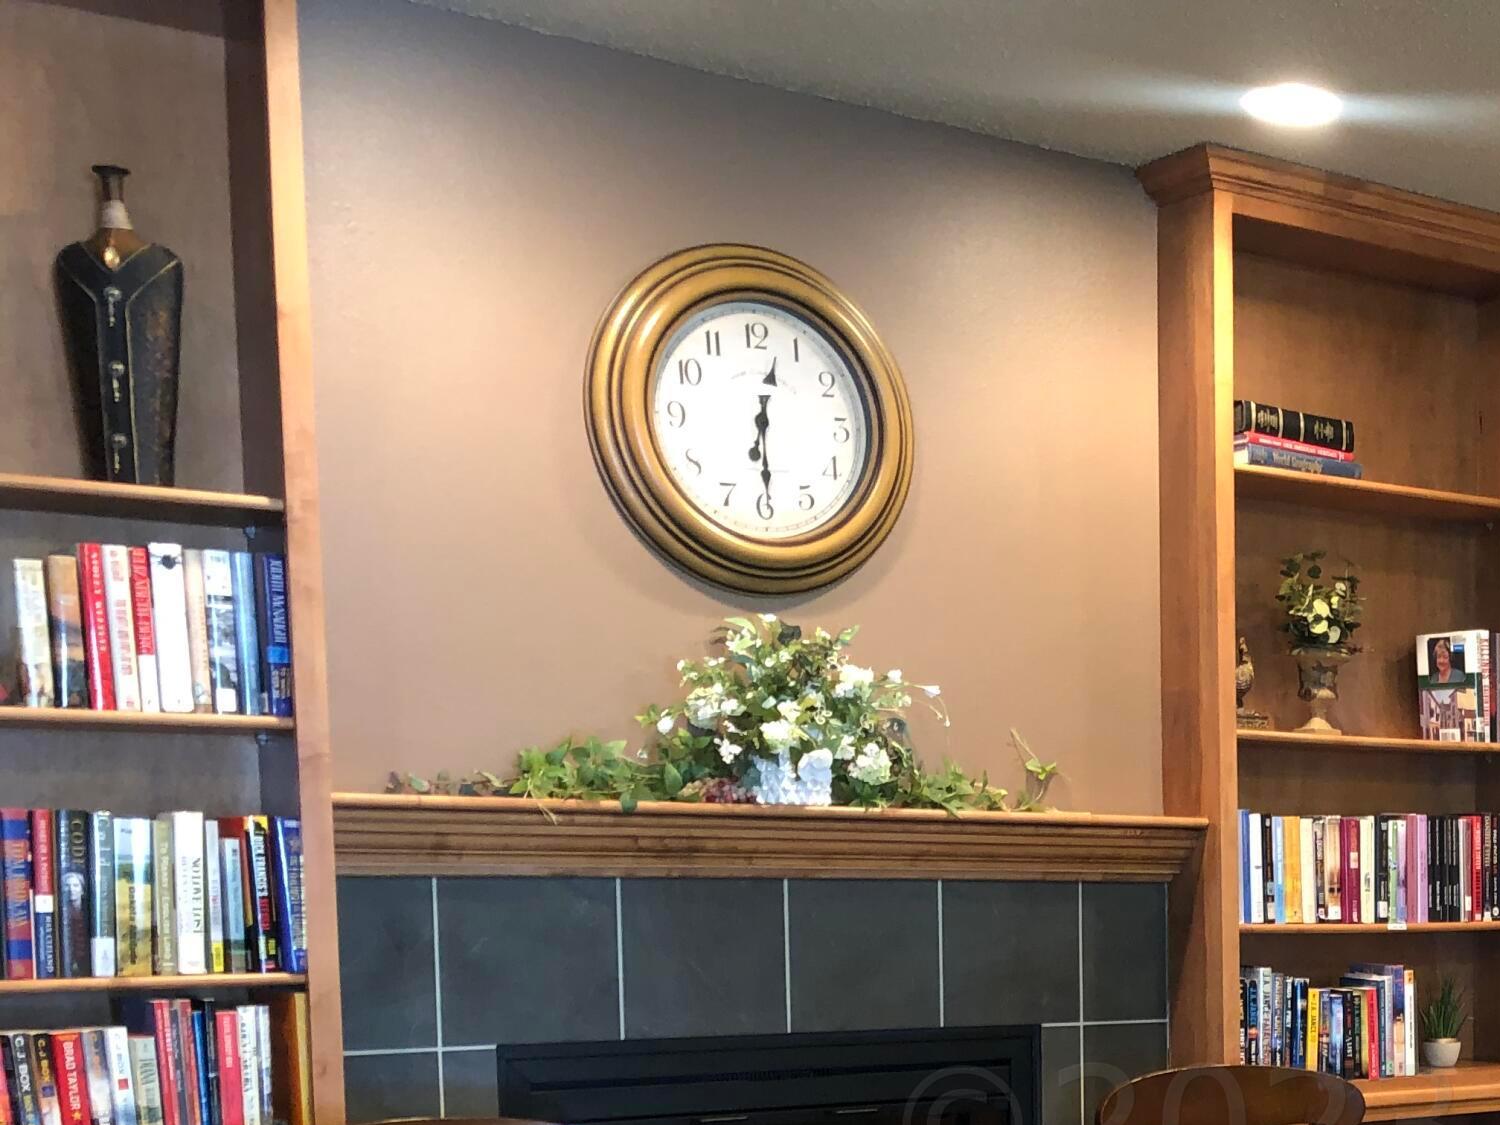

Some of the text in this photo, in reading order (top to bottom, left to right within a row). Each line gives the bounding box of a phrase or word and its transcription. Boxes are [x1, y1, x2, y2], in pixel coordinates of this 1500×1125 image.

[705, 330, 721, 356] 11
[744, 322, 769, 350] 12
[792, 337, 800, 363] 1
[678, 358, 702, 385] 10
[818, 371, 836, 398] 2
[666, 401, 686, 428] 9
[833, 417, 850, 443] 3
[685, 448, 702, 475] 8
[821, 456, 842, 481] 4
[719, 482, 737, 507] 7
[756, 492, 775, 520] 6
[798, 485, 815, 511] 5
[270, 559, 284, 592] JUDITH
[254, 836, 266, 855] DICK
[18, 1062, 31, 1092] BOX
[63, 1041, 80, 1110] BRAD TAYLOR
